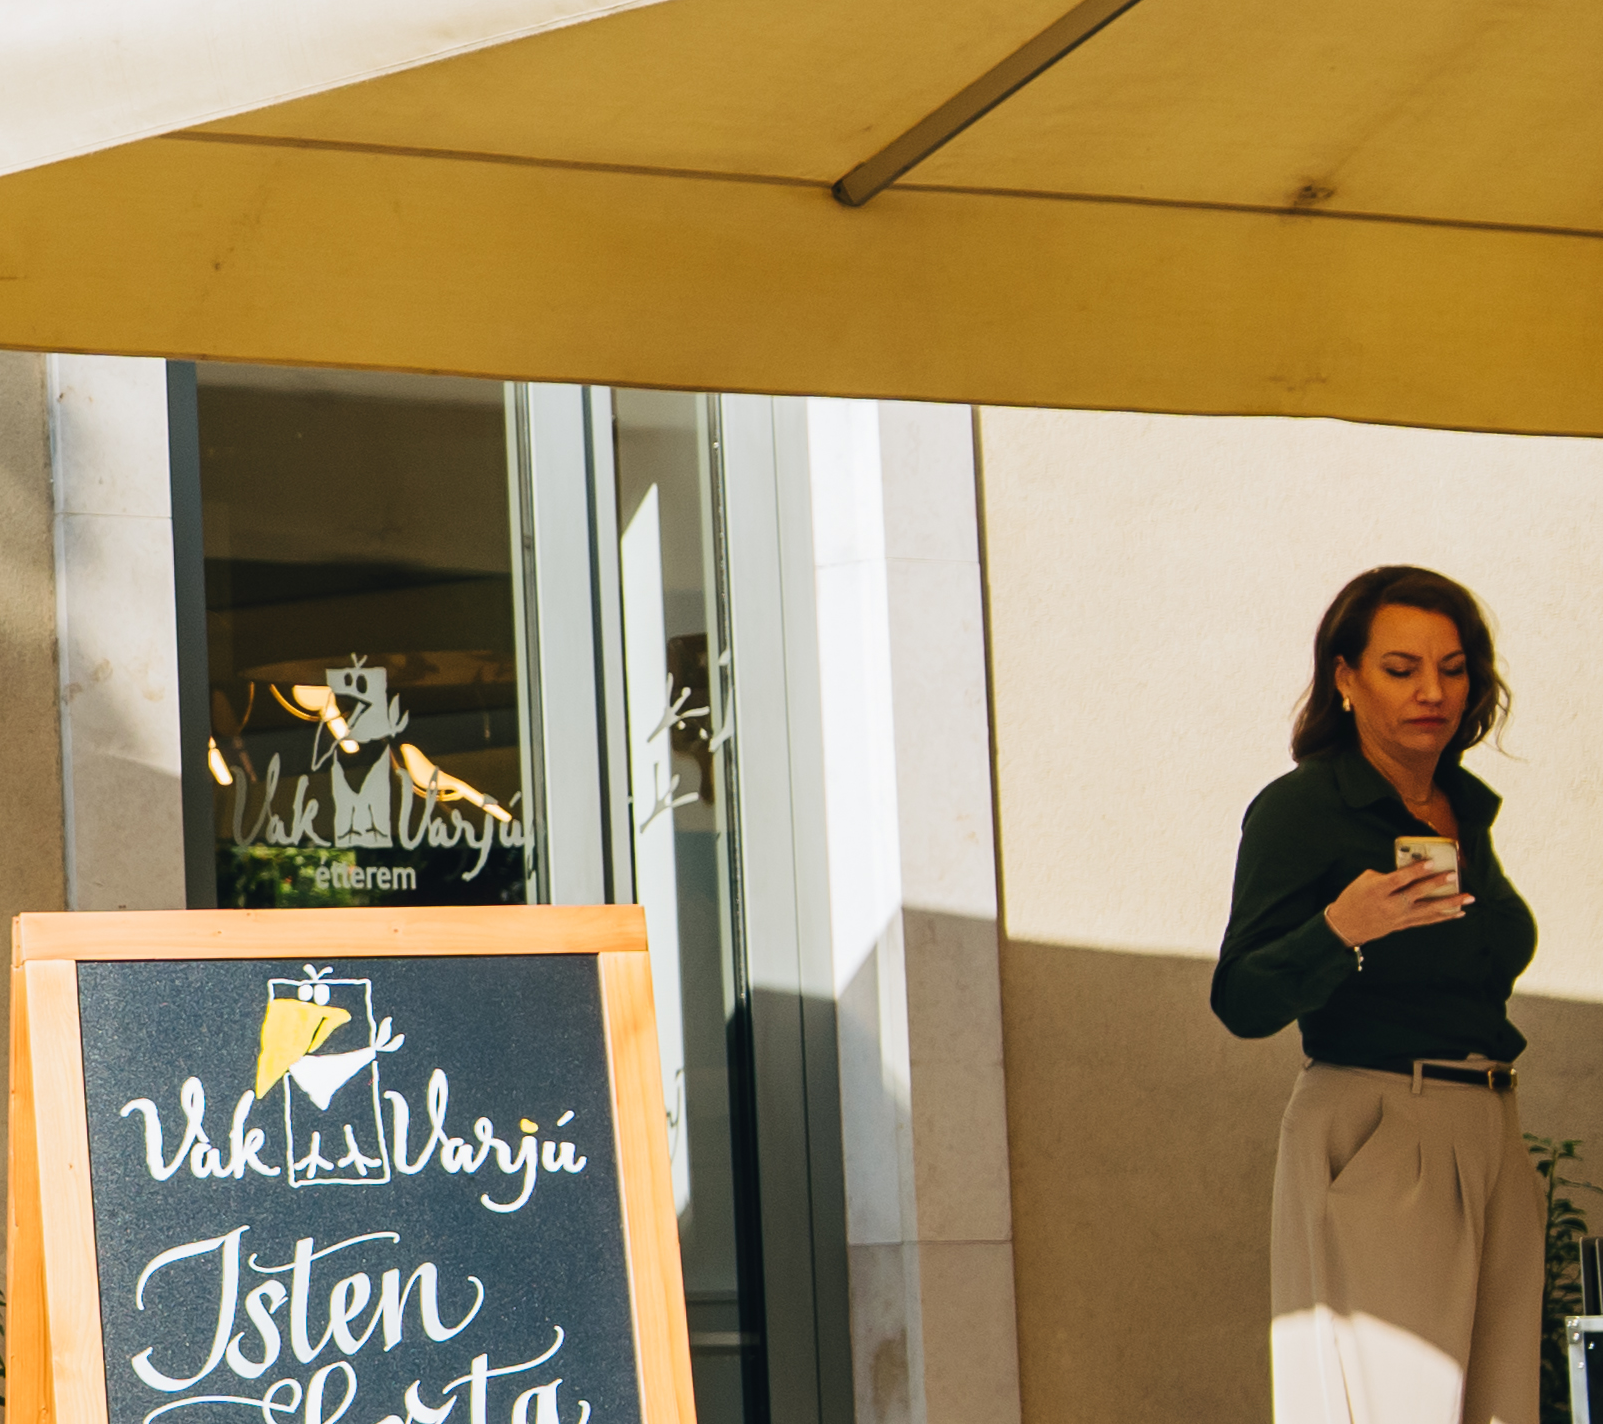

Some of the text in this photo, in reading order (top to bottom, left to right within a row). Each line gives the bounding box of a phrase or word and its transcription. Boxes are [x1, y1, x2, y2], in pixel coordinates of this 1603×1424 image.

[229, 751, 526, 882] Vak Varjú
[315, 855, 417, 890] étterem
[121, 1068, 588, 1213] Vak Varjú
[131, 1225, 483, 1392] Isten
